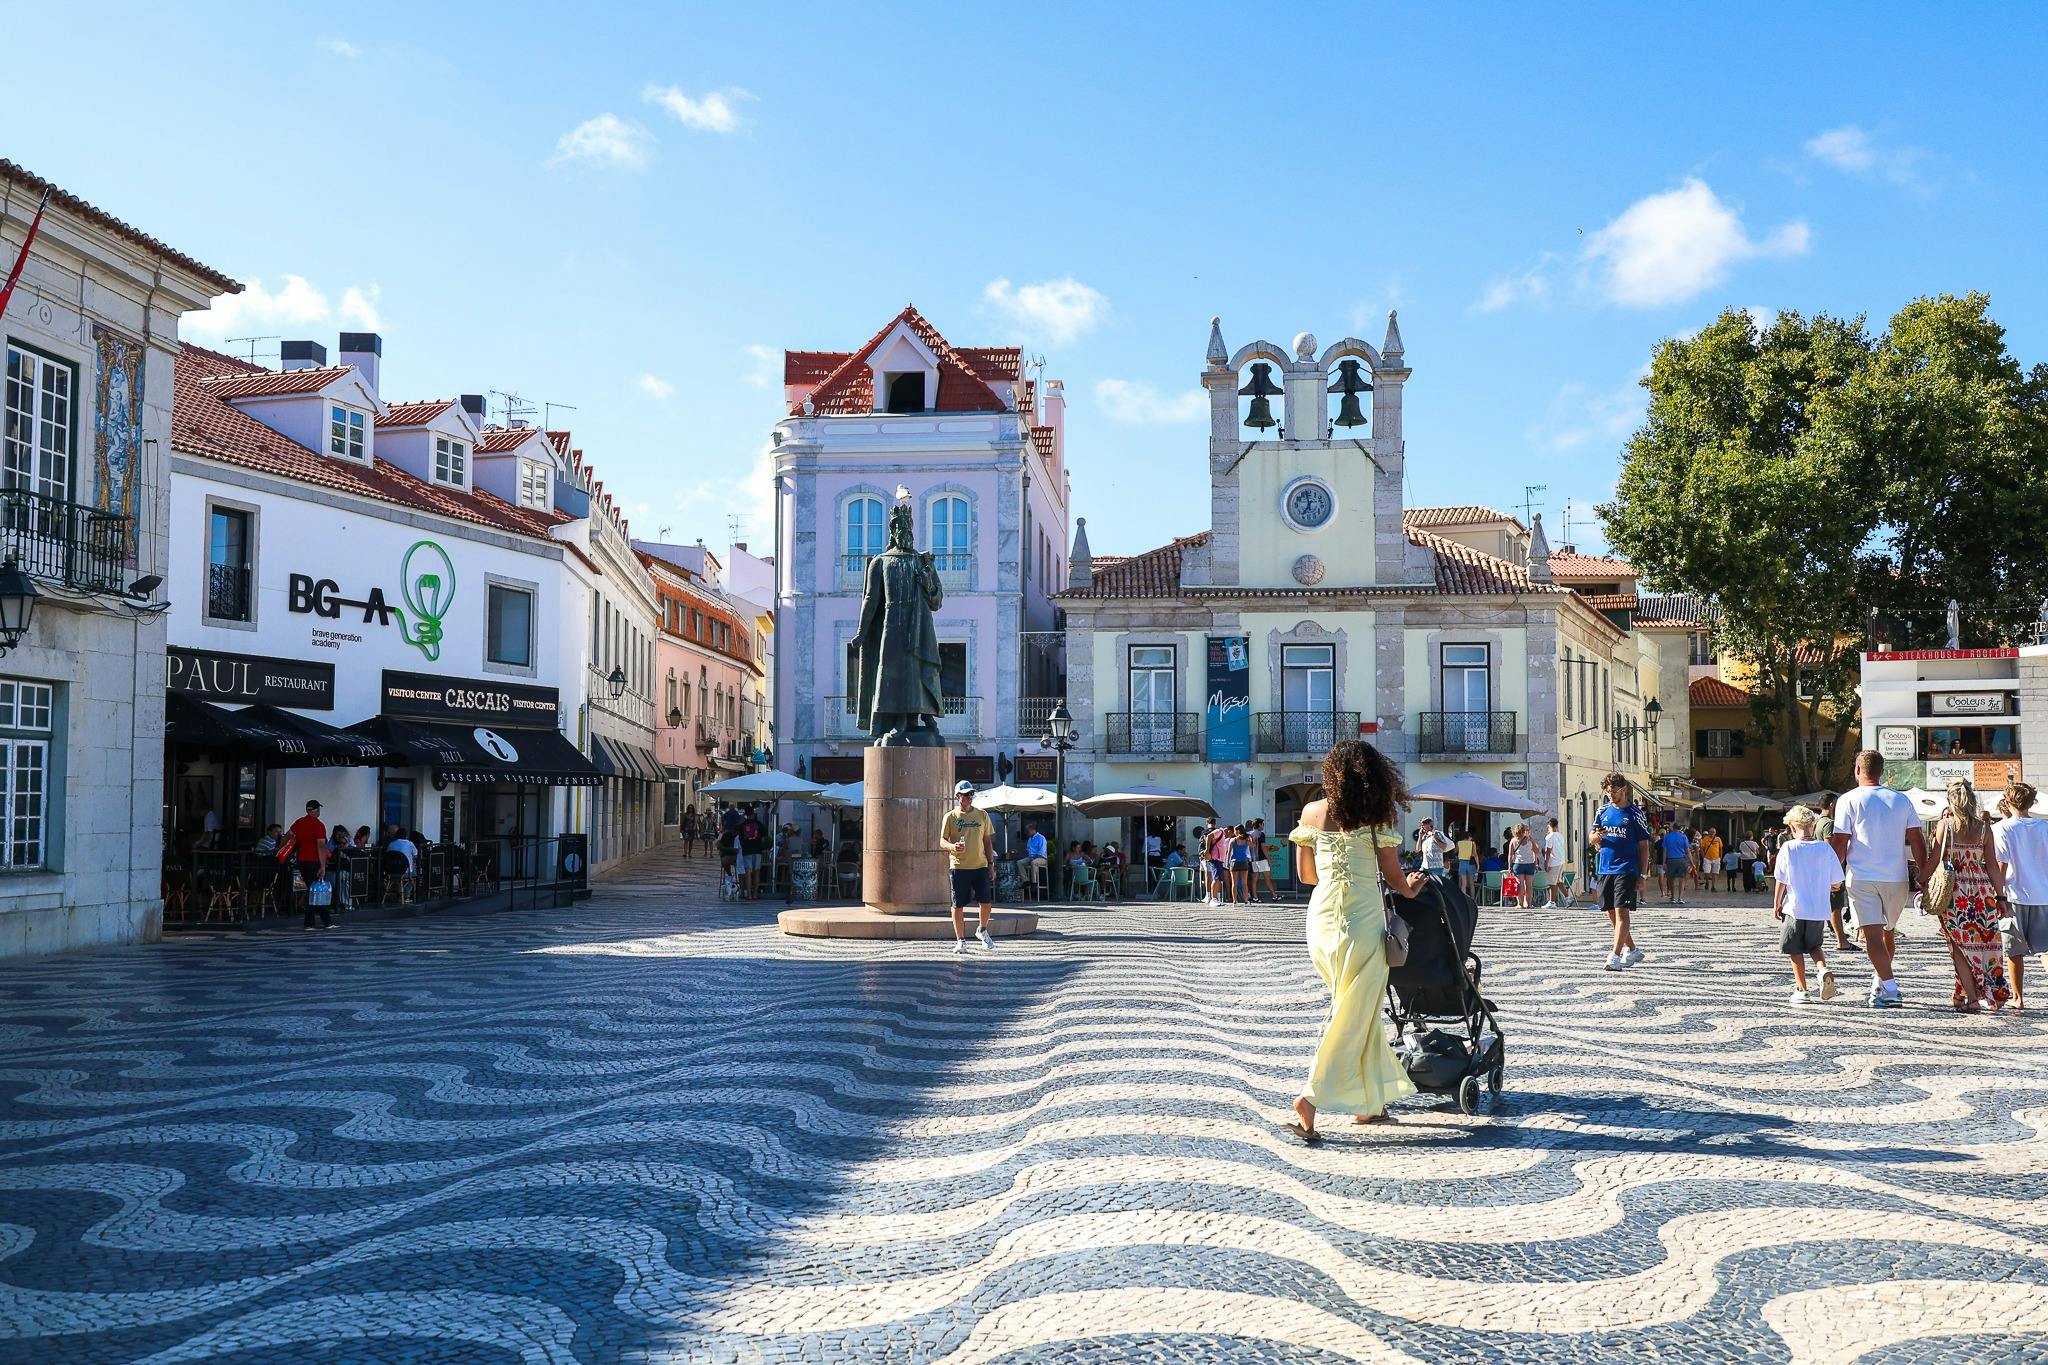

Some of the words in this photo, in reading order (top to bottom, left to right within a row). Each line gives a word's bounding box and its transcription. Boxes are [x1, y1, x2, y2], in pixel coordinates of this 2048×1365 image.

[312, 628, 330, 639] brave
[330, 632, 362, 643] generation
[312, 639, 340, 650] academy
[1899, 651, 1957, 660] STEAKHOUSE
[1970, 649, 2011, 659] ROOFTOP
[166, 656, 260, 695] PAUL
[264, 675, 328, 692] RESTAURANT
[388, 688, 415, 699] VISITOR
[416, 690, 442, 701] CENTER
[445, 689, 510, 712] CASCAIS
[513, 699, 535, 709] VISITOR
[535, 702, 556, 711] CENTER
[1945, 696, 1986, 708] Cooleys
[1882, 731, 1912, 741] Cooleys
[277, 739, 309, 755] PAUL
[357, 744, 388, 757] PAUL
[440, 751, 466, 764] PAUL
[1026, 761, 1053, 770] IRISH
[1030, 770, 1050, 778] PUB
[1930, 767, 1971, 778] Cooleys
[442, 773, 496, 783] CASCAIS
[504, 774, 549, 785] VISITOR
[557, 776, 599, 785] CENTER
